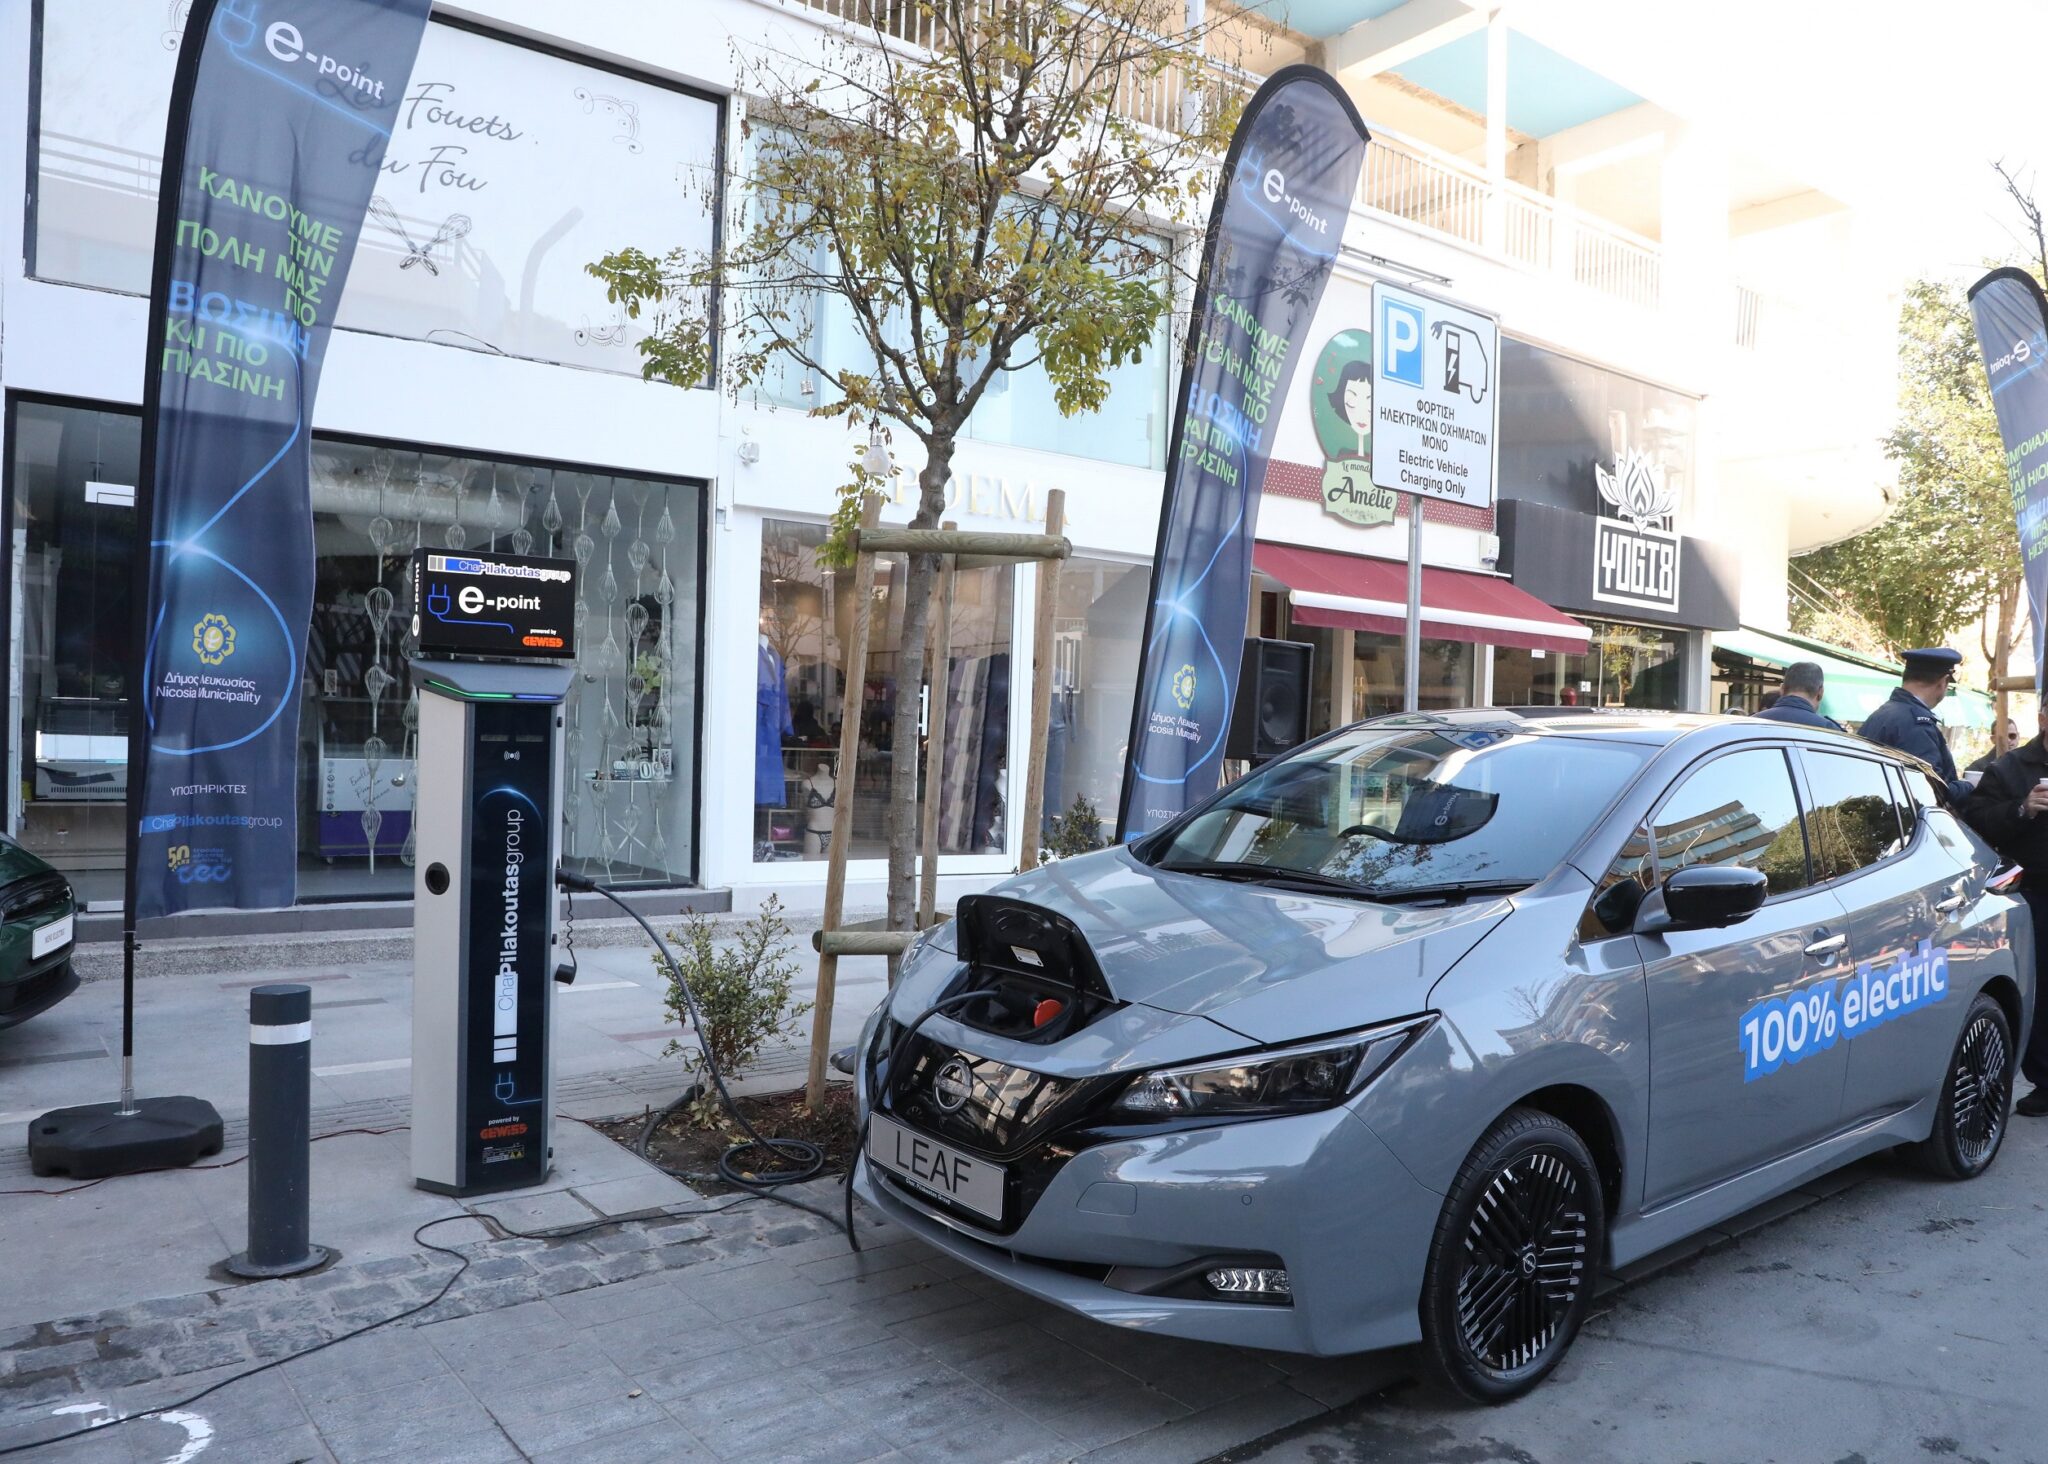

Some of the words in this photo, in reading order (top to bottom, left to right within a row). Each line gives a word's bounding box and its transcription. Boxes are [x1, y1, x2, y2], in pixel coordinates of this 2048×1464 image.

[264, 21, 385, 101] e-point
[405, 82, 524, 141] Fouets
[418, 145, 489, 194] Fou
[200, 166, 343, 253] ΚΑΝΟΥΜΕ
[1263, 168, 1328, 234] e-point
[176, 219, 266, 273] ΠΟΛΗ
[275, 254, 327, 304] ΜΑΣ
[287, 230, 334, 277] ΤΗΝ
[284, 288, 317, 327] ΠΙΟ
[215, 331, 269, 367] ΠΙΟ
[1387, 306, 1418, 373] P
[1250, 345, 1282, 381] ΤΗΝ
[1242, 364, 1275, 404] ΜΑΣ
[1243, 393, 1268, 424] ΠΙΟ
[1380, 406, 1438, 433] ΗΛΕΚΤΡΙΚΩΝ
[1440, 422, 1486, 446] ΟΧΗΜΑΤΩΝ
[1417, 399, 1455, 421] ΦΟΡΤΙΣΗ
[1209, 426, 1233, 457] ΠΙΟ
[1421, 434, 1448, 452] ΜΟΝΟ
[1350, 462, 1371, 474] mond
[1399, 449, 1434, 470] Electric
[1436, 458, 1469, 477] Vehicle
[1327, 476, 1393, 510] Amélie
[1400, 469, 1442, 493] Charging
[1445, 479, 1466, 498] Only
[1601, 531, 1675, 599] YOGI8
[412, 561, 420, 637] e-point
[458, 586, 541, 614] e-point
[156, 685, 198, 699] Nicosia
[198, 687, 261, 705] Municipality
[164, 671, 200, 687] Δήμος
[1148, 723, 1175, 736] icosia
[1151, 711, 1176, 726] Δήμος
[170, 784, 247, 797] ΥΠΟΣΤΗΡΙΚΤΕΣ
[1745, 990, 1836, 1069] 100%
[1844, 949, 1946, 1028] electric
[488, 1117, 512, 1126] powered
[896, 1131, 972, 1193] LEAF
